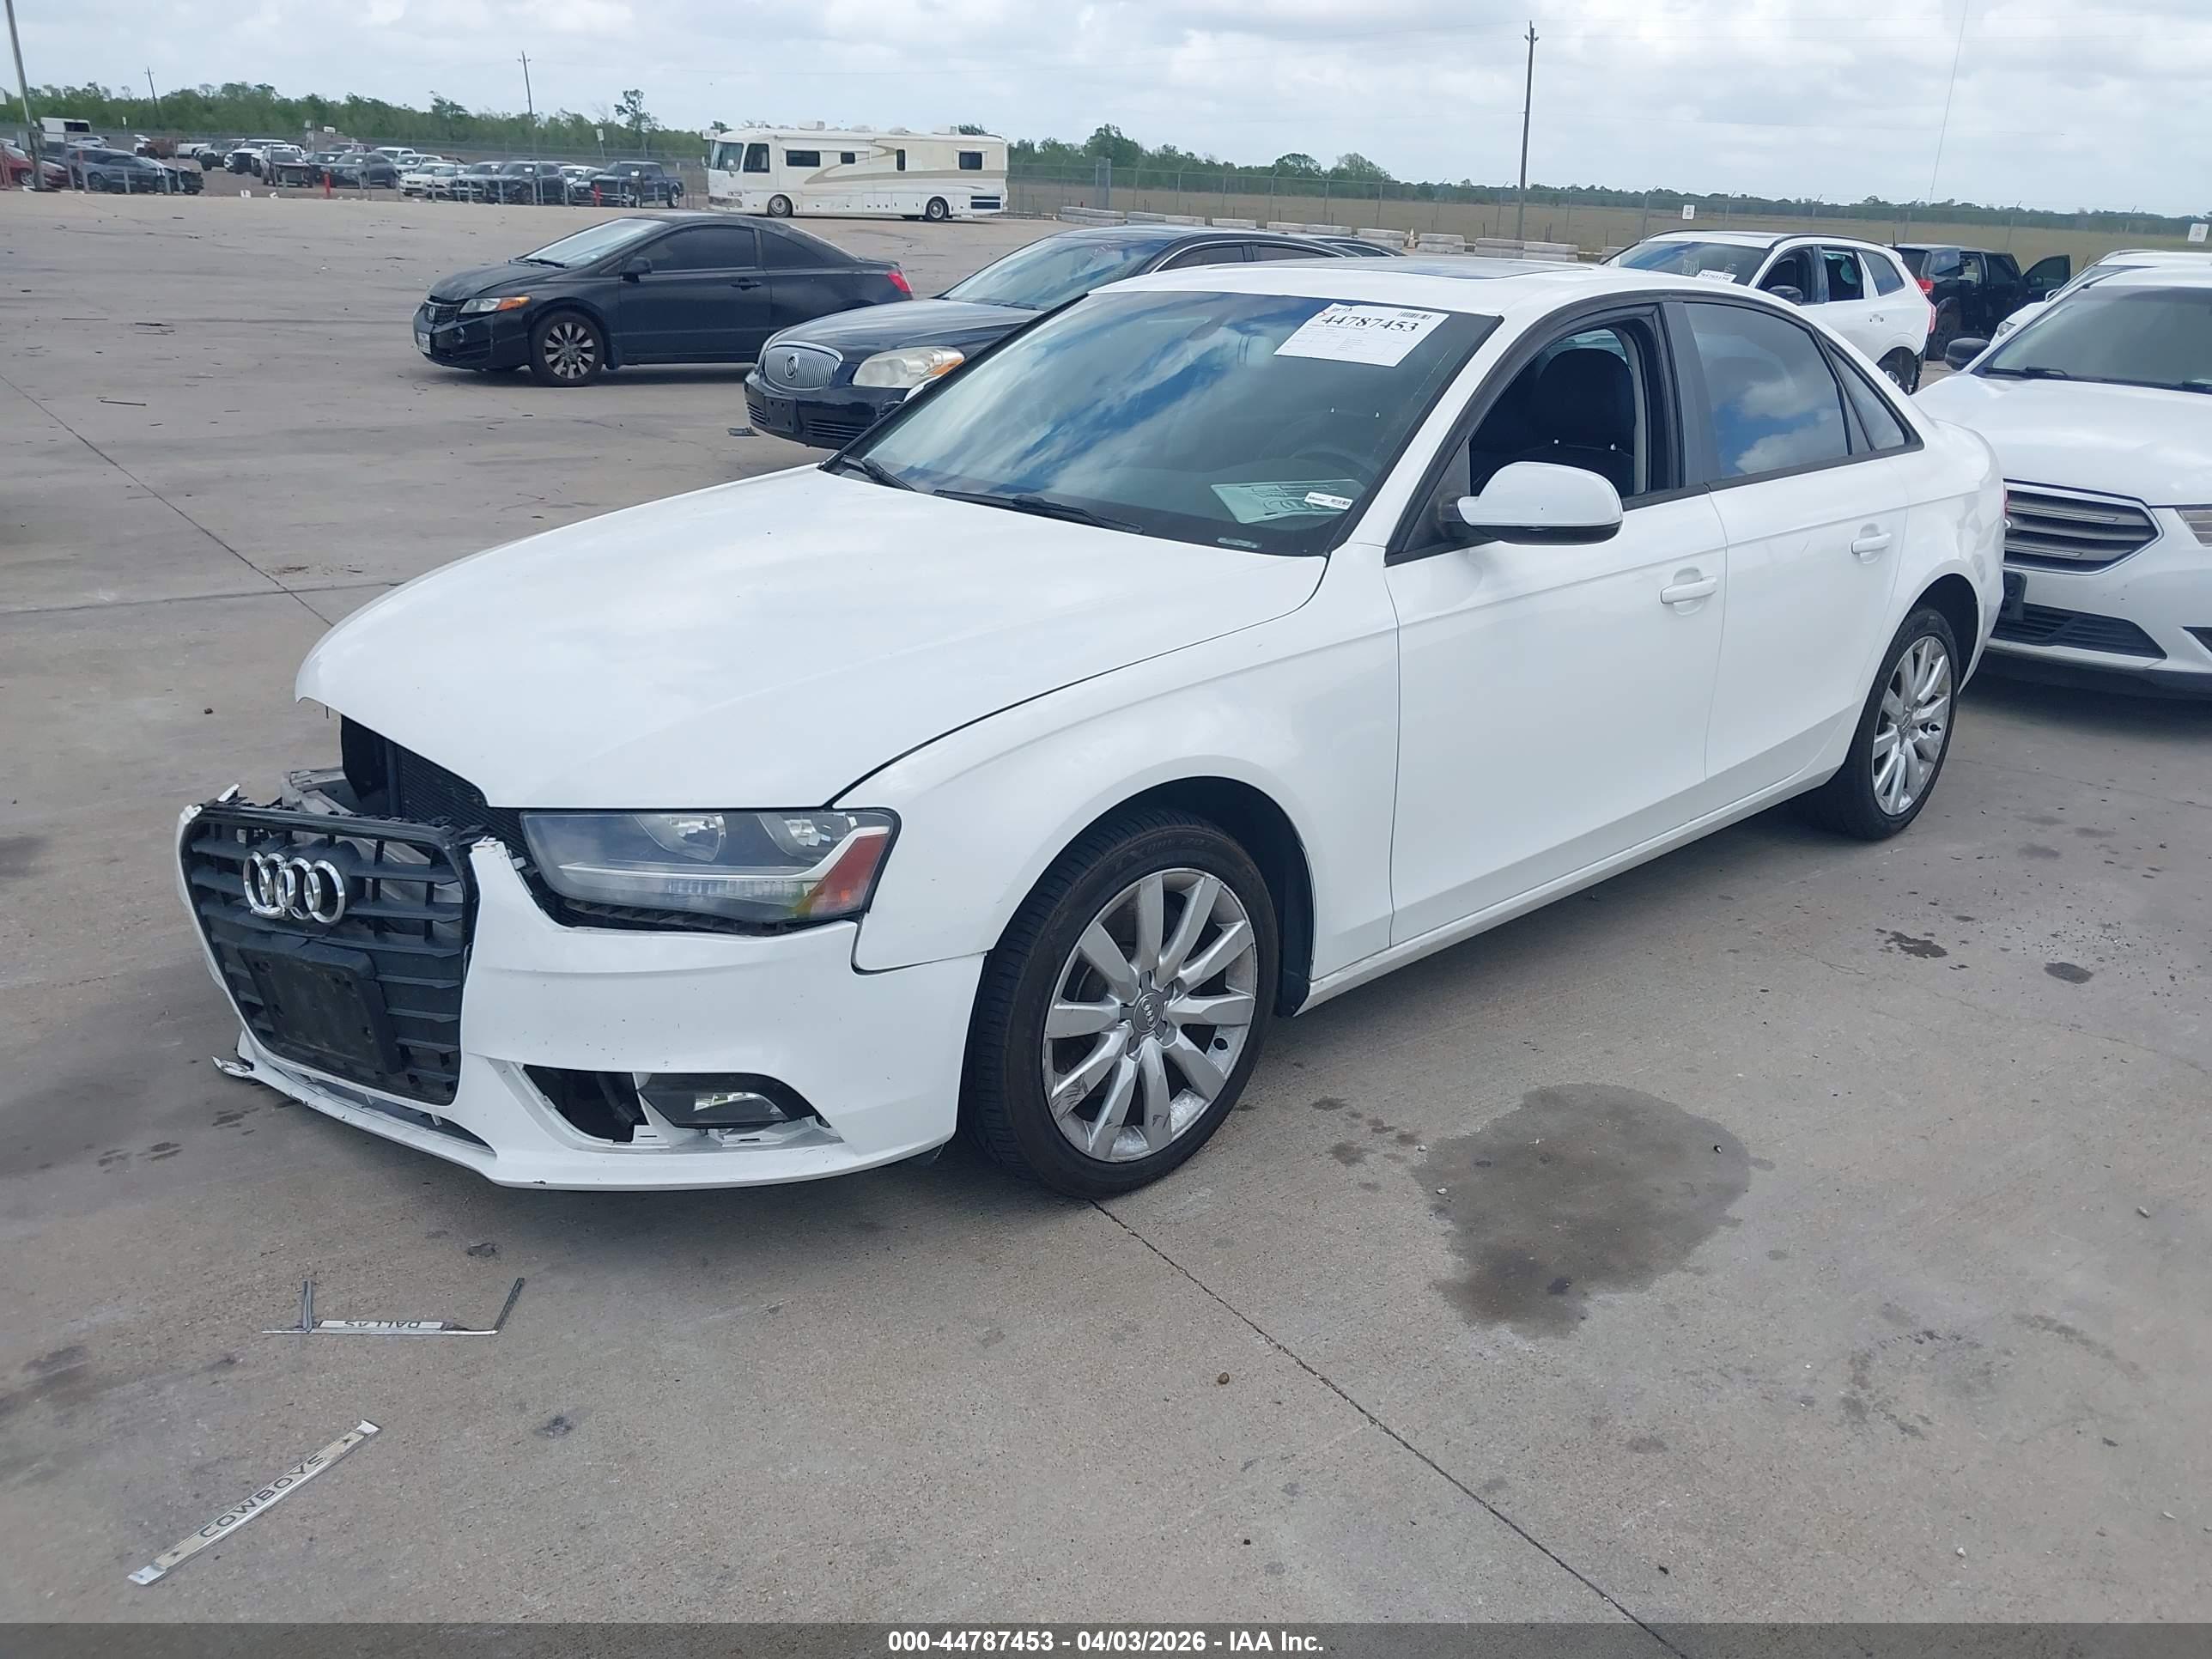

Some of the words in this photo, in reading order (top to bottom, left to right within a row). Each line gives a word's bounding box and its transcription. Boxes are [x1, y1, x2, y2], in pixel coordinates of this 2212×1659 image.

[1322, 314, 1419, 332] 44787453
[343, 1321, 421, 1329] DALLAS
[200, 1455, 324, 1538] COWBOYS
